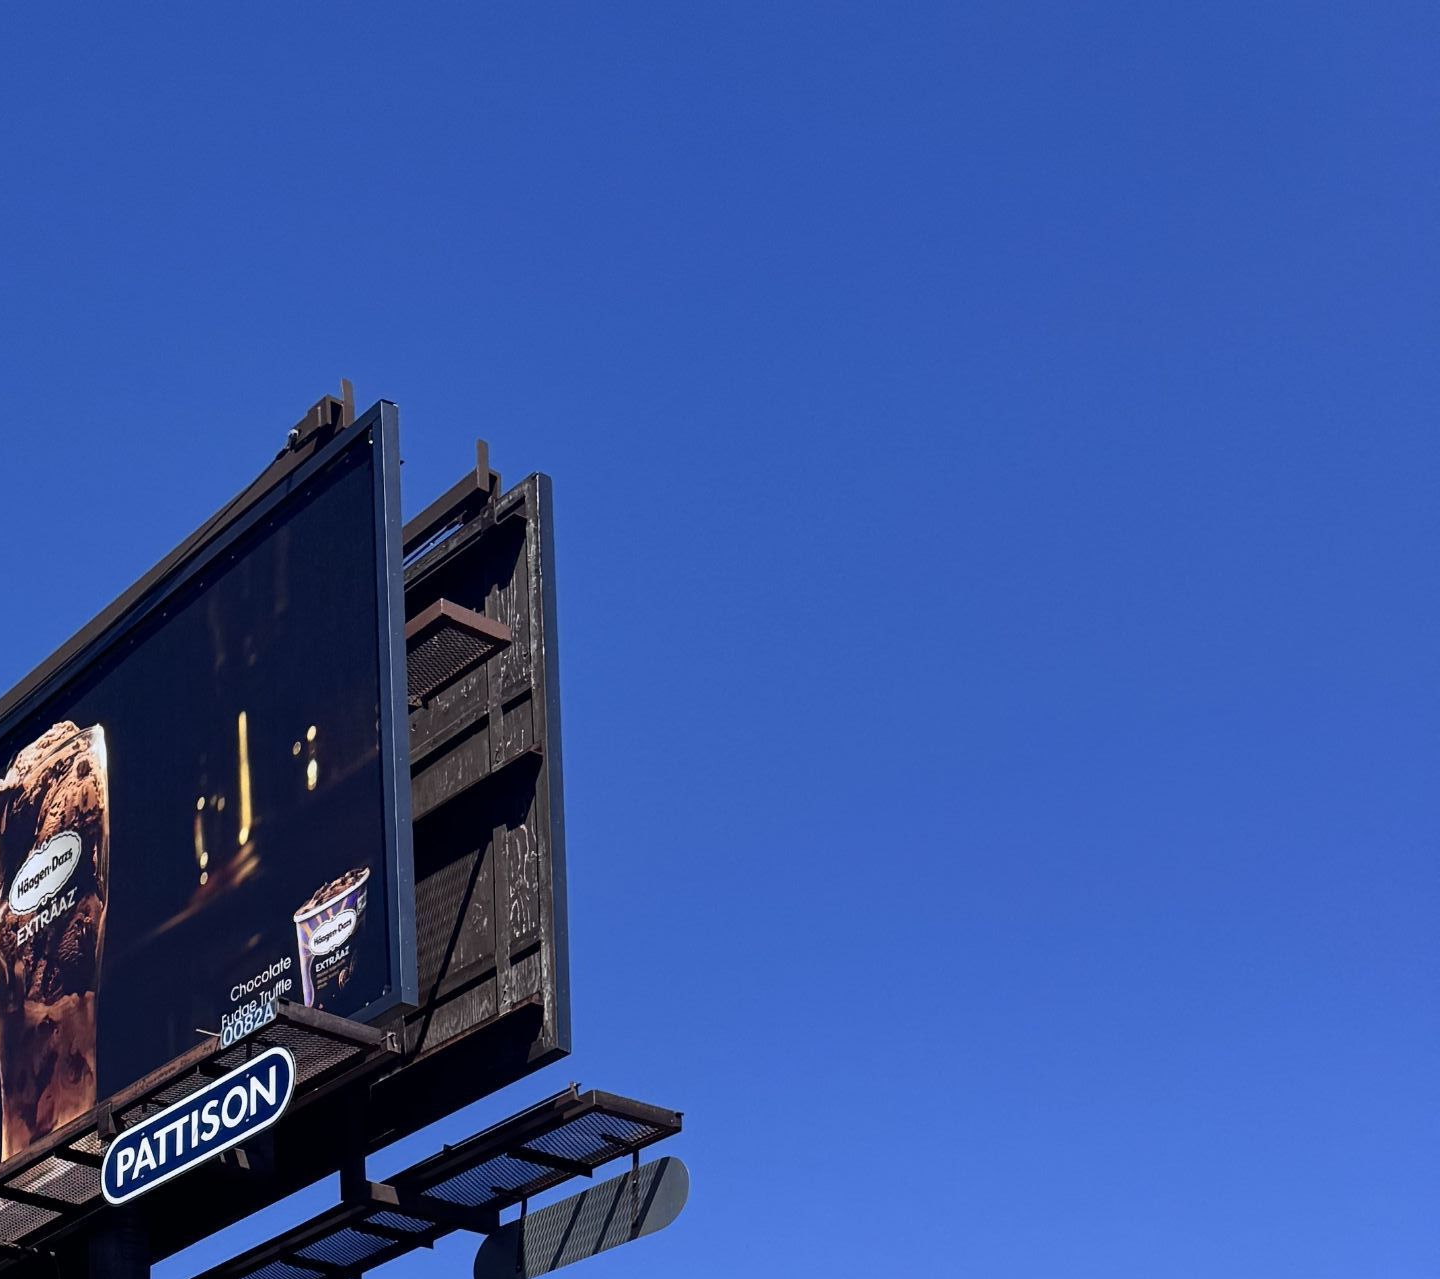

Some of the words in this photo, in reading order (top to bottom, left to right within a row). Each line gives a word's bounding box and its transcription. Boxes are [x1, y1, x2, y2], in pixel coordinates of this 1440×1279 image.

[16, 889, 77, 947] EXTRÄAZ
[230, 957, 292, 1002] Chocolate
[259, 978, 293, 1007] Truffle
[223, 1001, 275, 1046] 0082A
[116, 1065, 278, 1188] PATTISON
